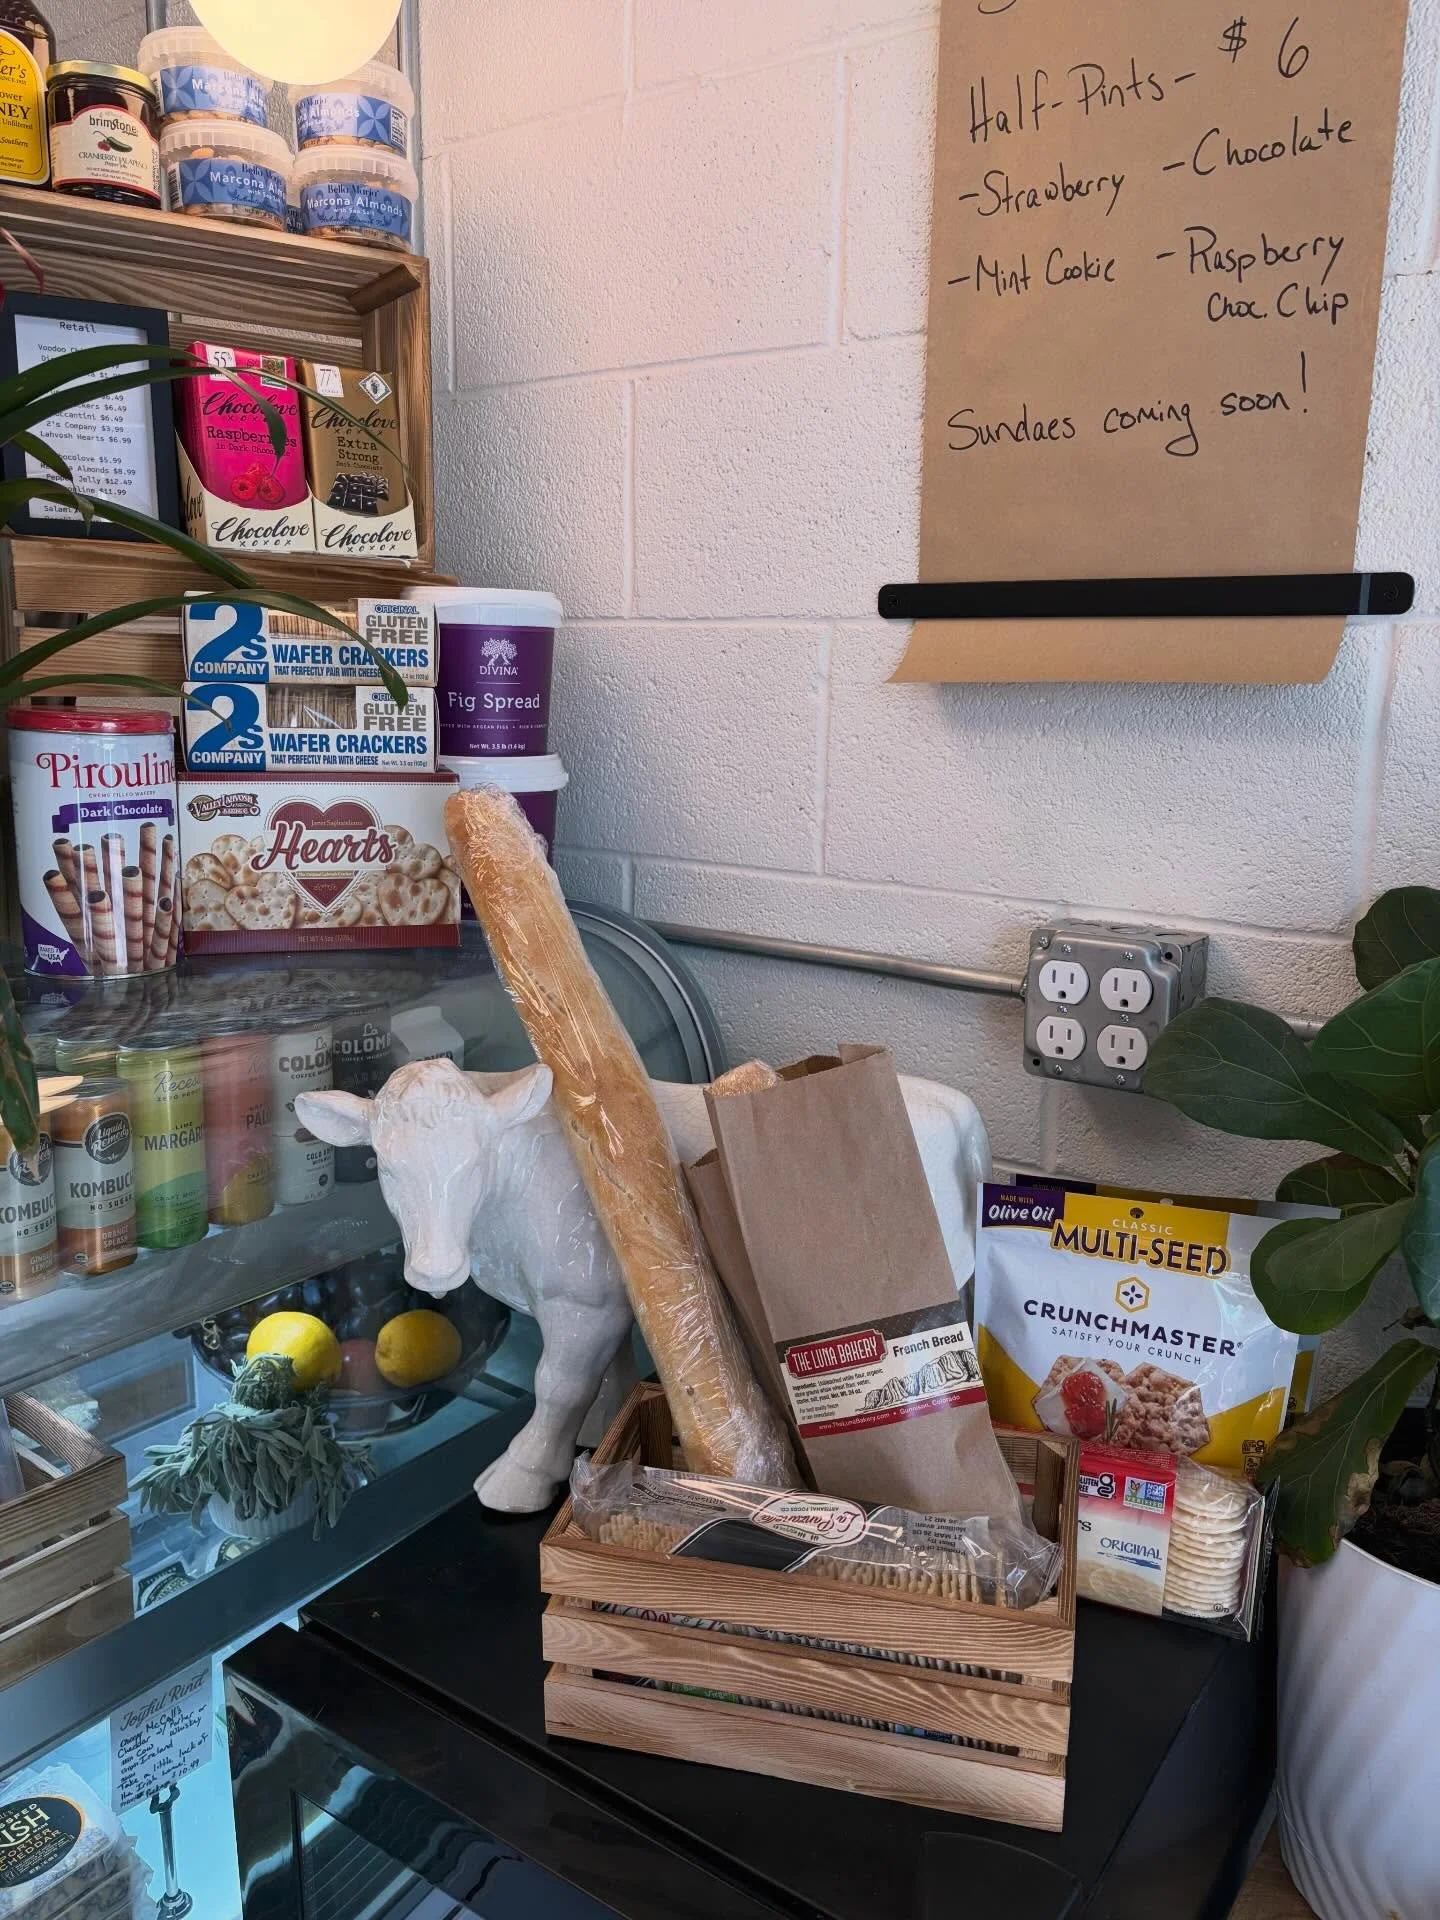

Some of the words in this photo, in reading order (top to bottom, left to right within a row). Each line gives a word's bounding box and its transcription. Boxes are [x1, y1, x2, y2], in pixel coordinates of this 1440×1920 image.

[1219, 16, 1248, 63] $
[1277, 17, 1310, 79] 6
[89, 114, 137, 134] brimstone
[210, 171, 264, 189] Marcona
[307, 197, 350, 210] Marcona
[357, 197, 402, 217] Almonds
[1045, 248, 1117, 287] Cookie
[1276, 283, 1350, 325] Chip
[60, 321, 96, 334] Retail
[65, 421, 97, 432] Company
[947, 404, 1076, 451] Sundaes
[1103, 401, 1200, 457] coming
[337, 436, 378, 451] Extra
[338, 448, 380, 466] Strong
[77, 465, 110, 474] Almonds
[79, 475, 101, 485] Jelly
[210, 515, 310, 542] Chocolove
[320, 521, 412, 549] Chocolove
[374, 603, 420, 615] ORIGINAL
[365, 614, 428, 629] GLUTEN
[366, 628, 429, 645] FREE
[271, 643, 337, 665] WAFER
[194, 661, 267, 676] COMPANY
[274, 665, 290, 676] THAT
[291, 666, 325, 677] PERFECTLY
[325, 667, 340, 677] PAIR
[341, 667, 357, 678] WITH
[479, 665, 519, 676] DIVINA
[363, 702, 426, 716] GLUTEN
[447, 691, 477, 712] Fig
[483, 692, 541, 713] Spread
[363, 716, 427, 732] FREE
[268, 732, 330, 753] WAFER
[335, 733, 428, 755] CRACKERS
[191, 751, 263, 764] COMPANY
[271, 754, 287, 764] THAT
[287, 755, 322, 765] PERFECTLY
[322, 755, 338, 765] PAIR
[338, 755, 354, 766] WITH
[355, 755, 379, 766] CHEESE
[80, 806, 111, 818] Dark
[113, 804, 163, 815] Chocolate
[251, 821, 397, 871] Hearts
[291, 1071, 317, 1080] COFFEE
[90, 1202, 103, 1212] NO
[1000, 1193, 1017, 1203] MADE
[1018, 1196, 1034, 1205] WITH
[988, 1204, 1029, 1221] Olive
[1031, 1205, 1055, 1222] Oil
[16, 1228, 29, 1237] NO
[102, 1225, 129, 1240] ORANGE
[1112, 1218, 1174, 1235] CLASSIC
[1053, 1222, 1227, 1276] MULTI-SEED
[1023, 1299, 1237, 1357] CRUNCHMASTER
[791, 1352, 812, 1373] THE
[812, 1347, 838, 1369] LUNA
[838, 1336, 878, 1364] BAKERY
[893, 1339, 930, 1358] French
[932, 1330, 964, 1348] Bread
[1052, 1326, 1101, 1344] SATISFY
[1108, 1337, 1141, 1353] YOUR
[1147, 1346, 1202, 1365] CRUNCH
[931, 1395, 961, 1408] Colorado
[1147, 1483, 1165, 1492] NON
[837, 1510, 861, 1532] La
[933, 1531, 952, 1539] MAR
[936, 1545, 966, 1556] Product
[1100, 1536, 1162, 1561] ORIGINAL
[169, 1668, 209, 1703] Rind
[117, 1735, 151, 1759] Cheddar
[136, 1743, 154, 1757] Cow
[116, 1777, 138, 1791] Take
[153, 1756, 174, 1773] little
[179, 1741, 196, 1758] luck
[197, 1733, 209, 1747] of
[135, 1776, 158, 1793] Irish
[0, 1827, 52, 1865] PORTER
[0, 1829, 62, 1872] CHEDDAR
